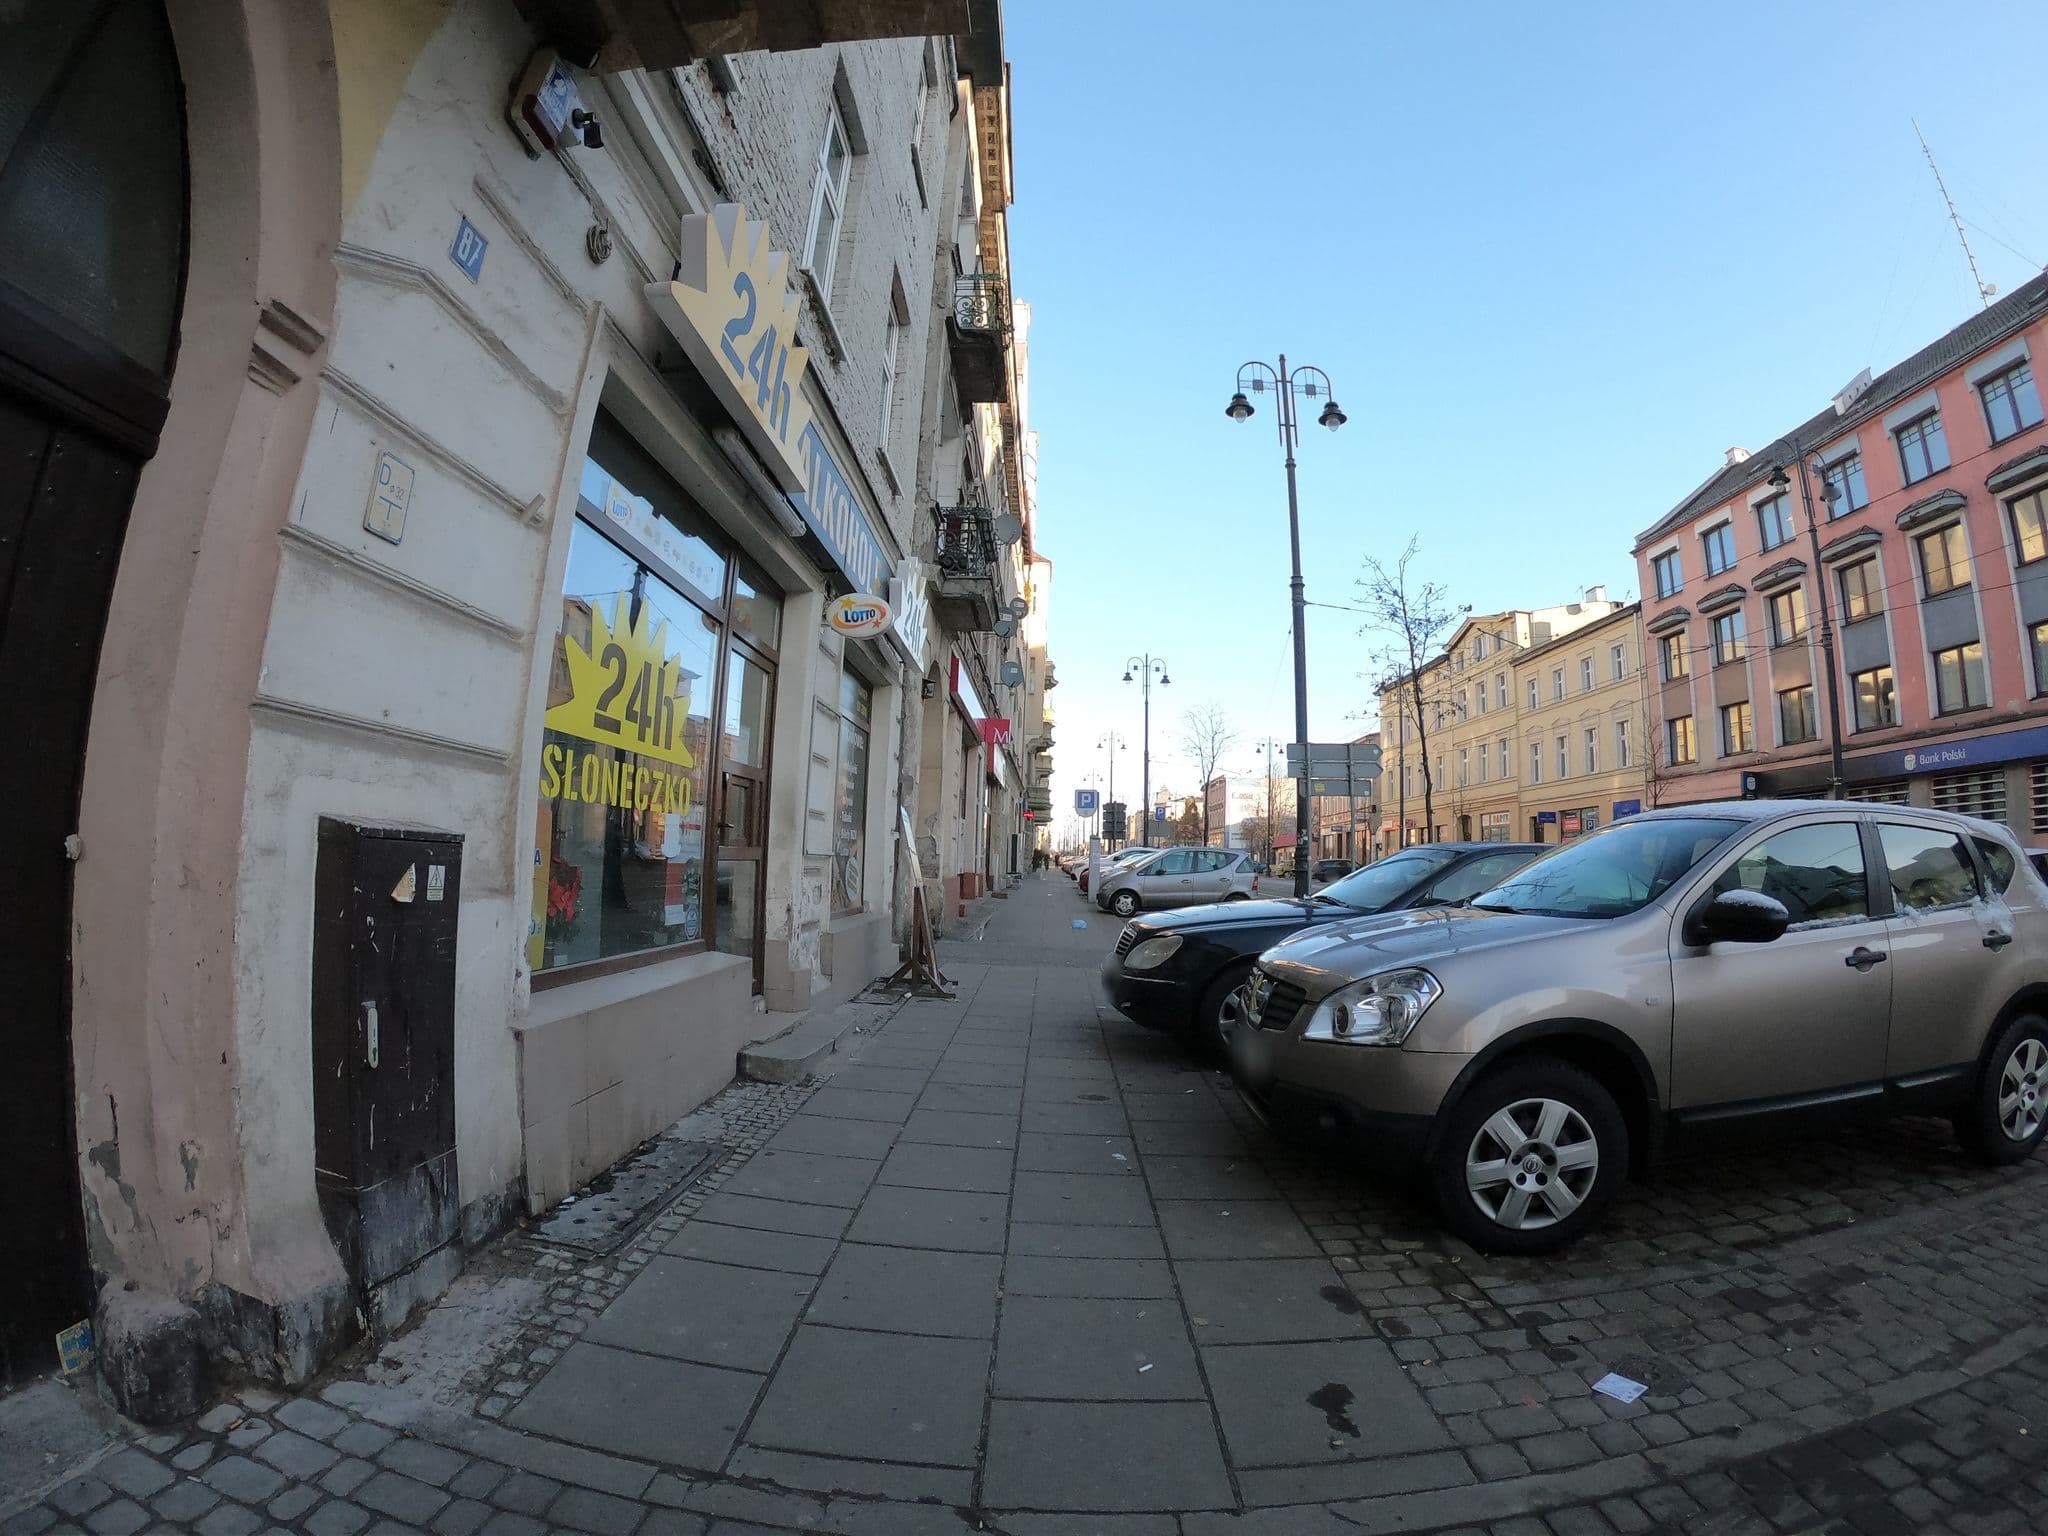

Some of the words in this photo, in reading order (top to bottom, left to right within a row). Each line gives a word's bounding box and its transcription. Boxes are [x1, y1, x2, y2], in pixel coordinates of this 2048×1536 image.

[457, 226, 483, 268] 87
[720, 270, 791, 446] 24h
[844, 608, 876, 623] LOTTO
[903, 590, 921, 657] 24h
[593, 642, 675, 751] 24h
[540, 743, 692, 817] SŁONECZKO
[1919, 752, 1940, 765] Bank
[1942, 748, 1966, 762] Polski
[1081, 793, 1091, 807] P
